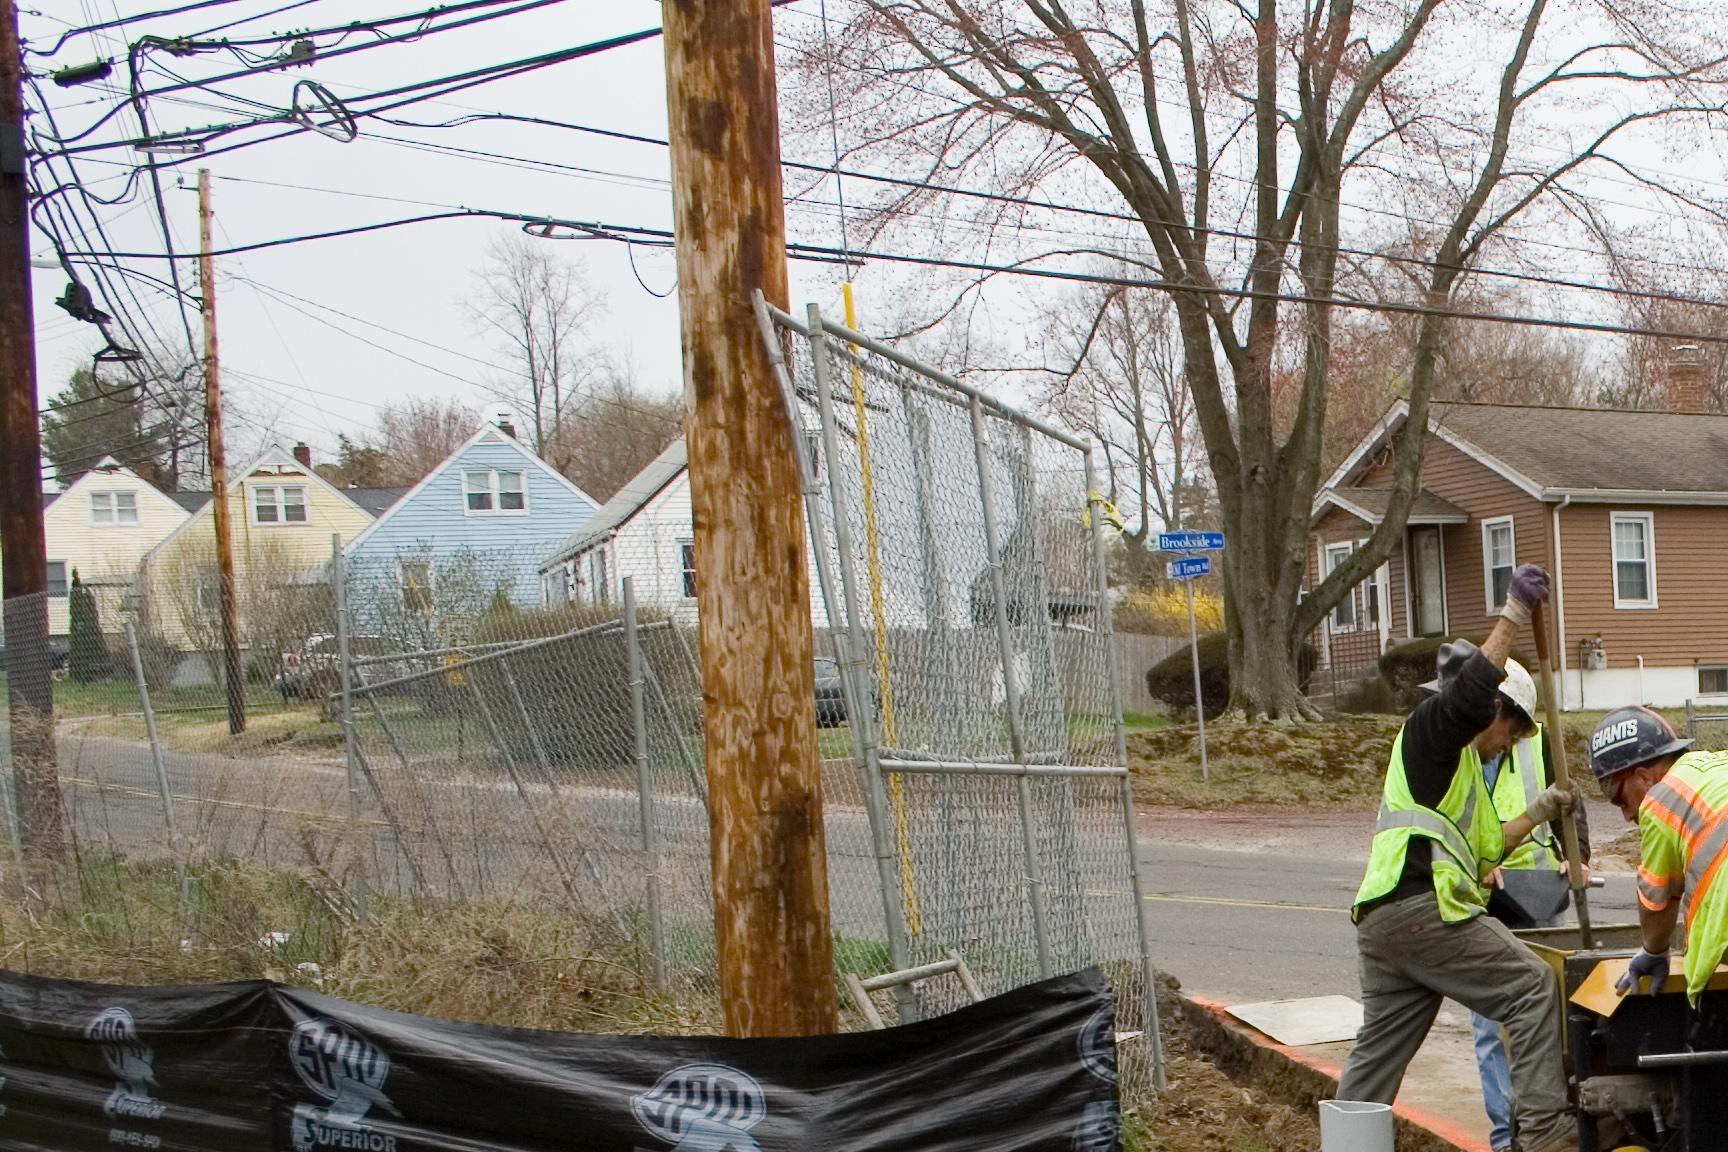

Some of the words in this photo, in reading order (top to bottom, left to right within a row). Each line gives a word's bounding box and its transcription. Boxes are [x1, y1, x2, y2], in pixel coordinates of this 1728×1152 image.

[1161, 534, 1210, 549] Brookside
[1183, 562, 1202, 575] Town
[1591, 718, 1639, 752] GIANTS
